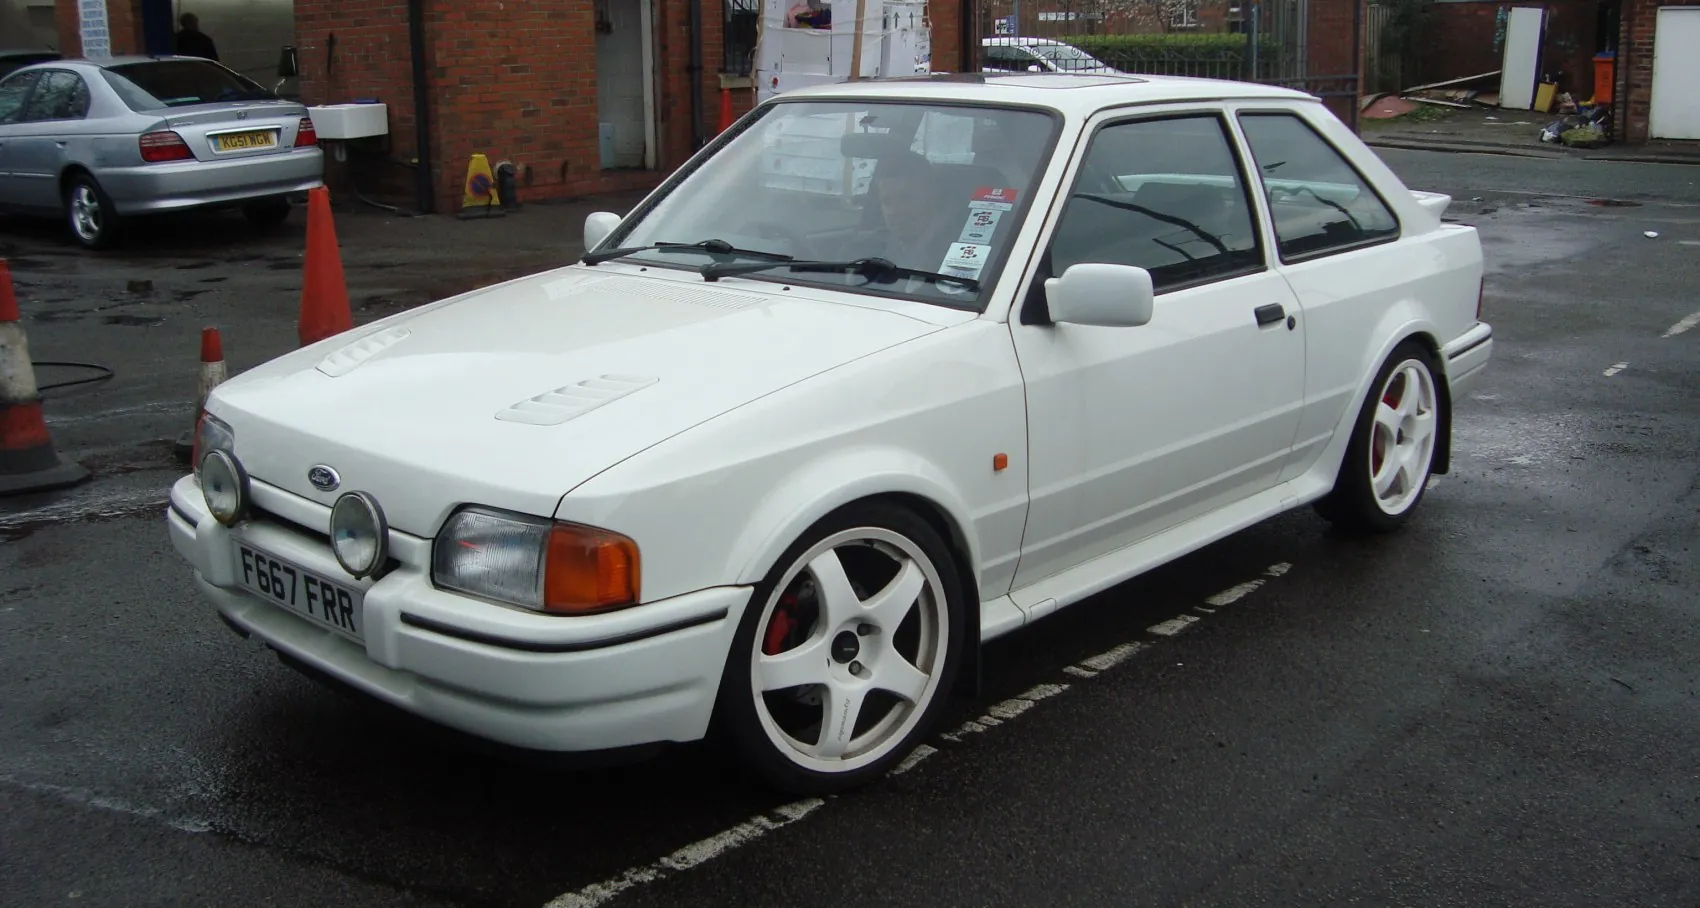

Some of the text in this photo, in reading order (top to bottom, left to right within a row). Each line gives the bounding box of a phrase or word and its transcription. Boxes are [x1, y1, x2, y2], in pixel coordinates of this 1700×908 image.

[222, 135, 248, 149] KG51
[311, 468, 332, 485] Ford
[240, 547, 356, 632] F667 FRR
